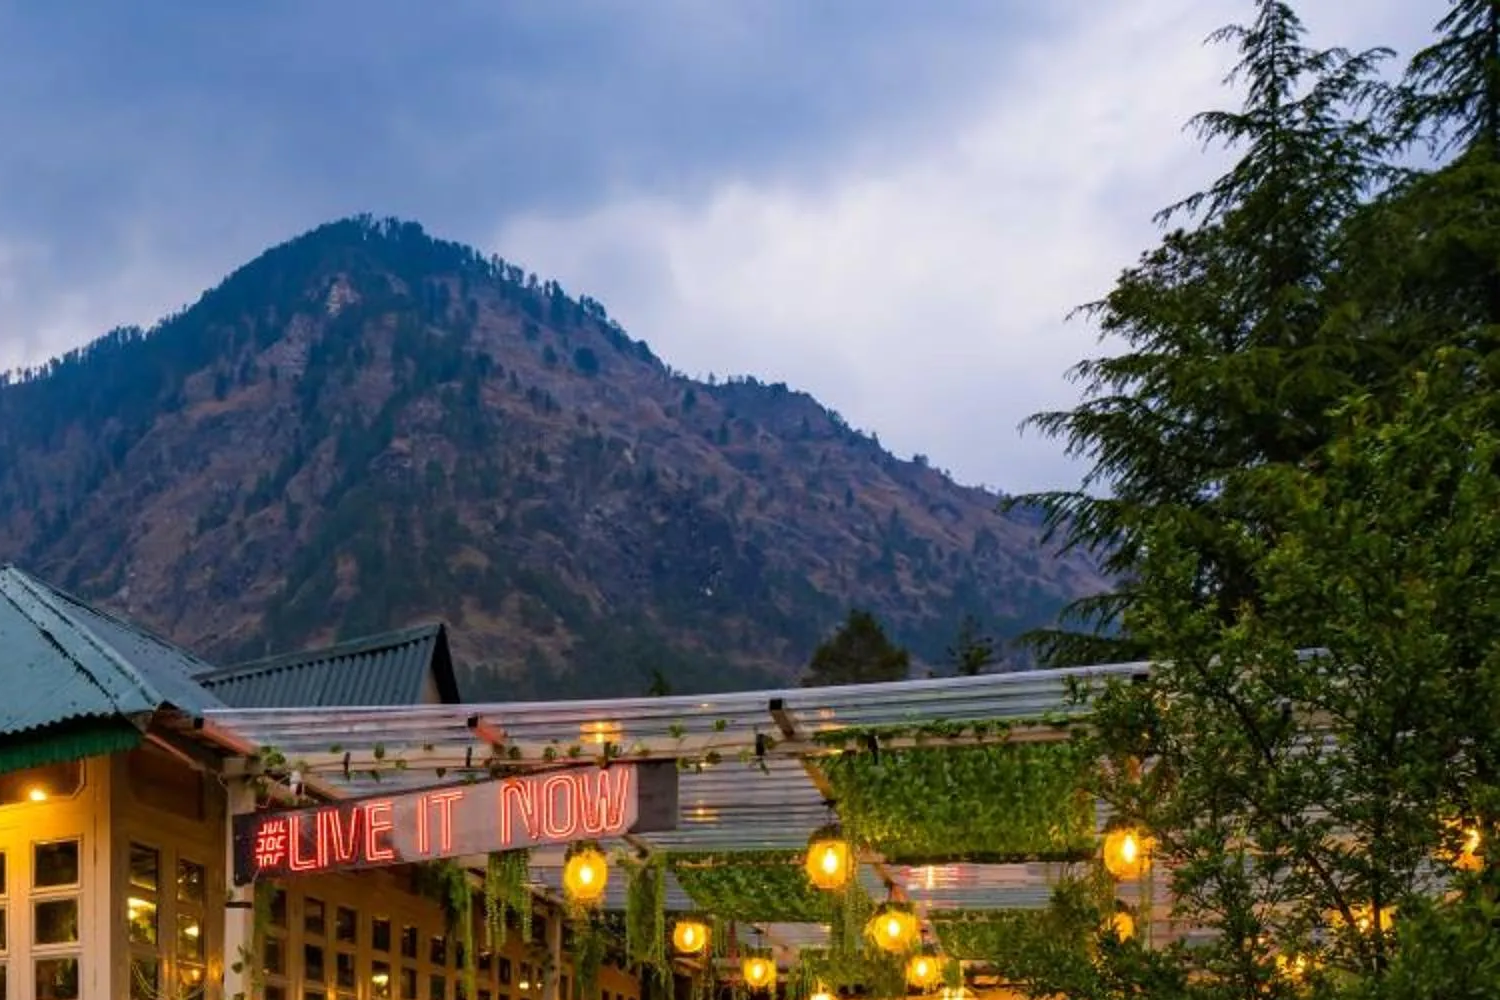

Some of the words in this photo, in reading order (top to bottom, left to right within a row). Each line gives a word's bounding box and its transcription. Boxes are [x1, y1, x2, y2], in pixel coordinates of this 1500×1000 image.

[256, 801, 394, 871] #LIVE
[417, 791, 464, 855] IT
[500, 768, 629, 845] NOW
